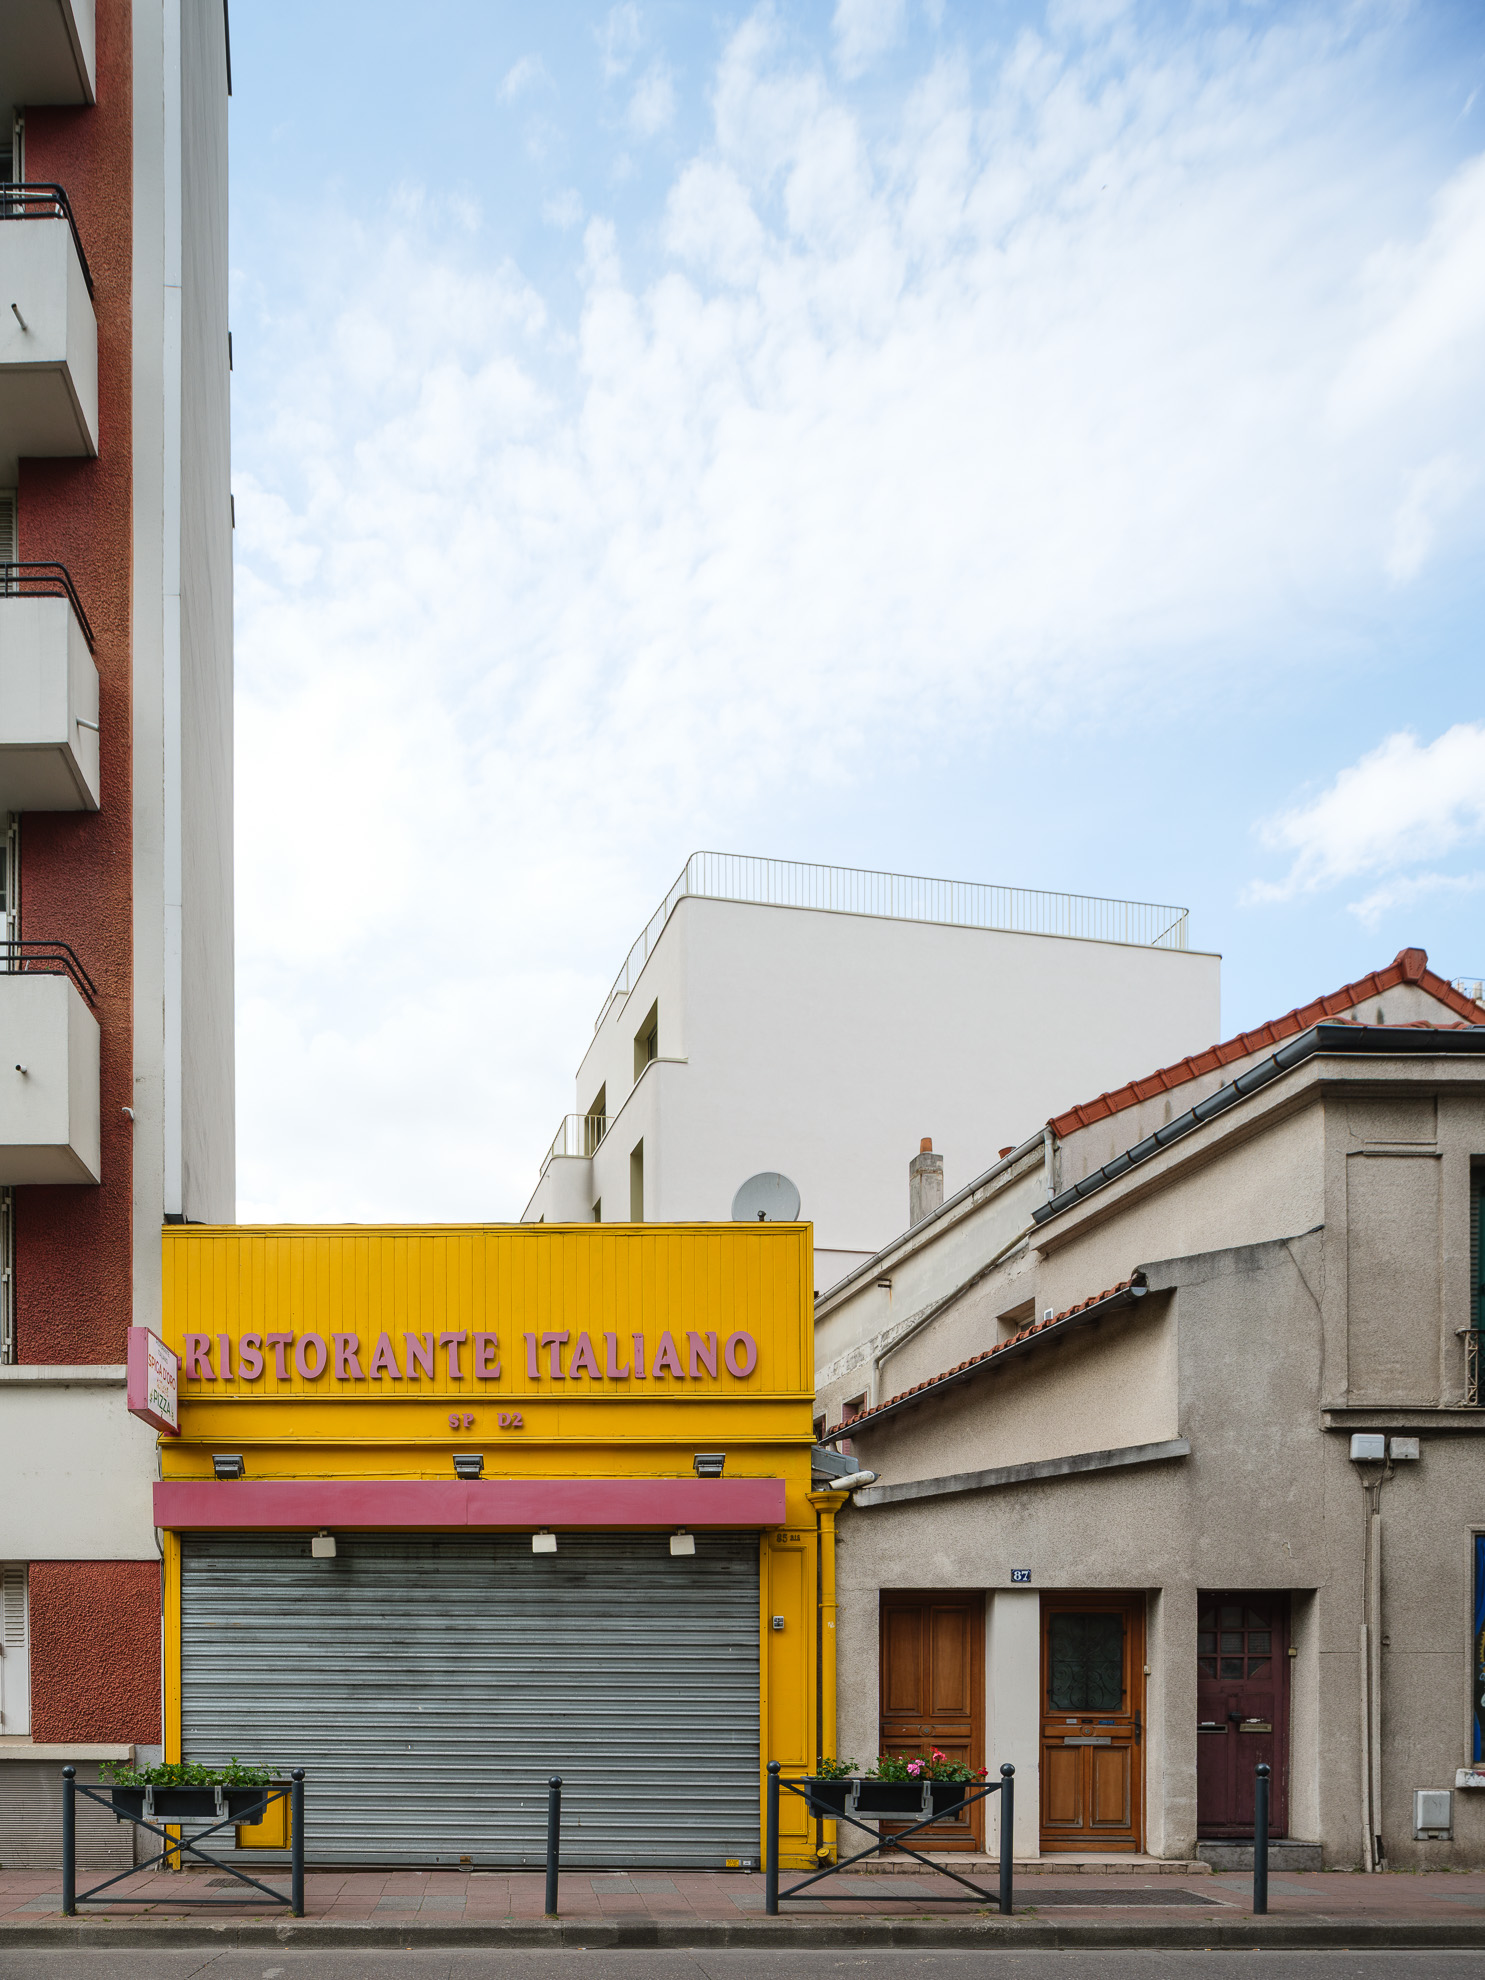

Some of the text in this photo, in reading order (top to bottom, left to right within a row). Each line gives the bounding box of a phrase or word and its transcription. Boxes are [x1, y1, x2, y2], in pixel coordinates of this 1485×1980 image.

[182, 1329, 757, 1379] RISTORANTE ITALIANO
[153, 1389, 171, 1416] PIZZA
[776, 1533, 788, 1543] 85
[1013, 1570, 1029, 1581] 87
